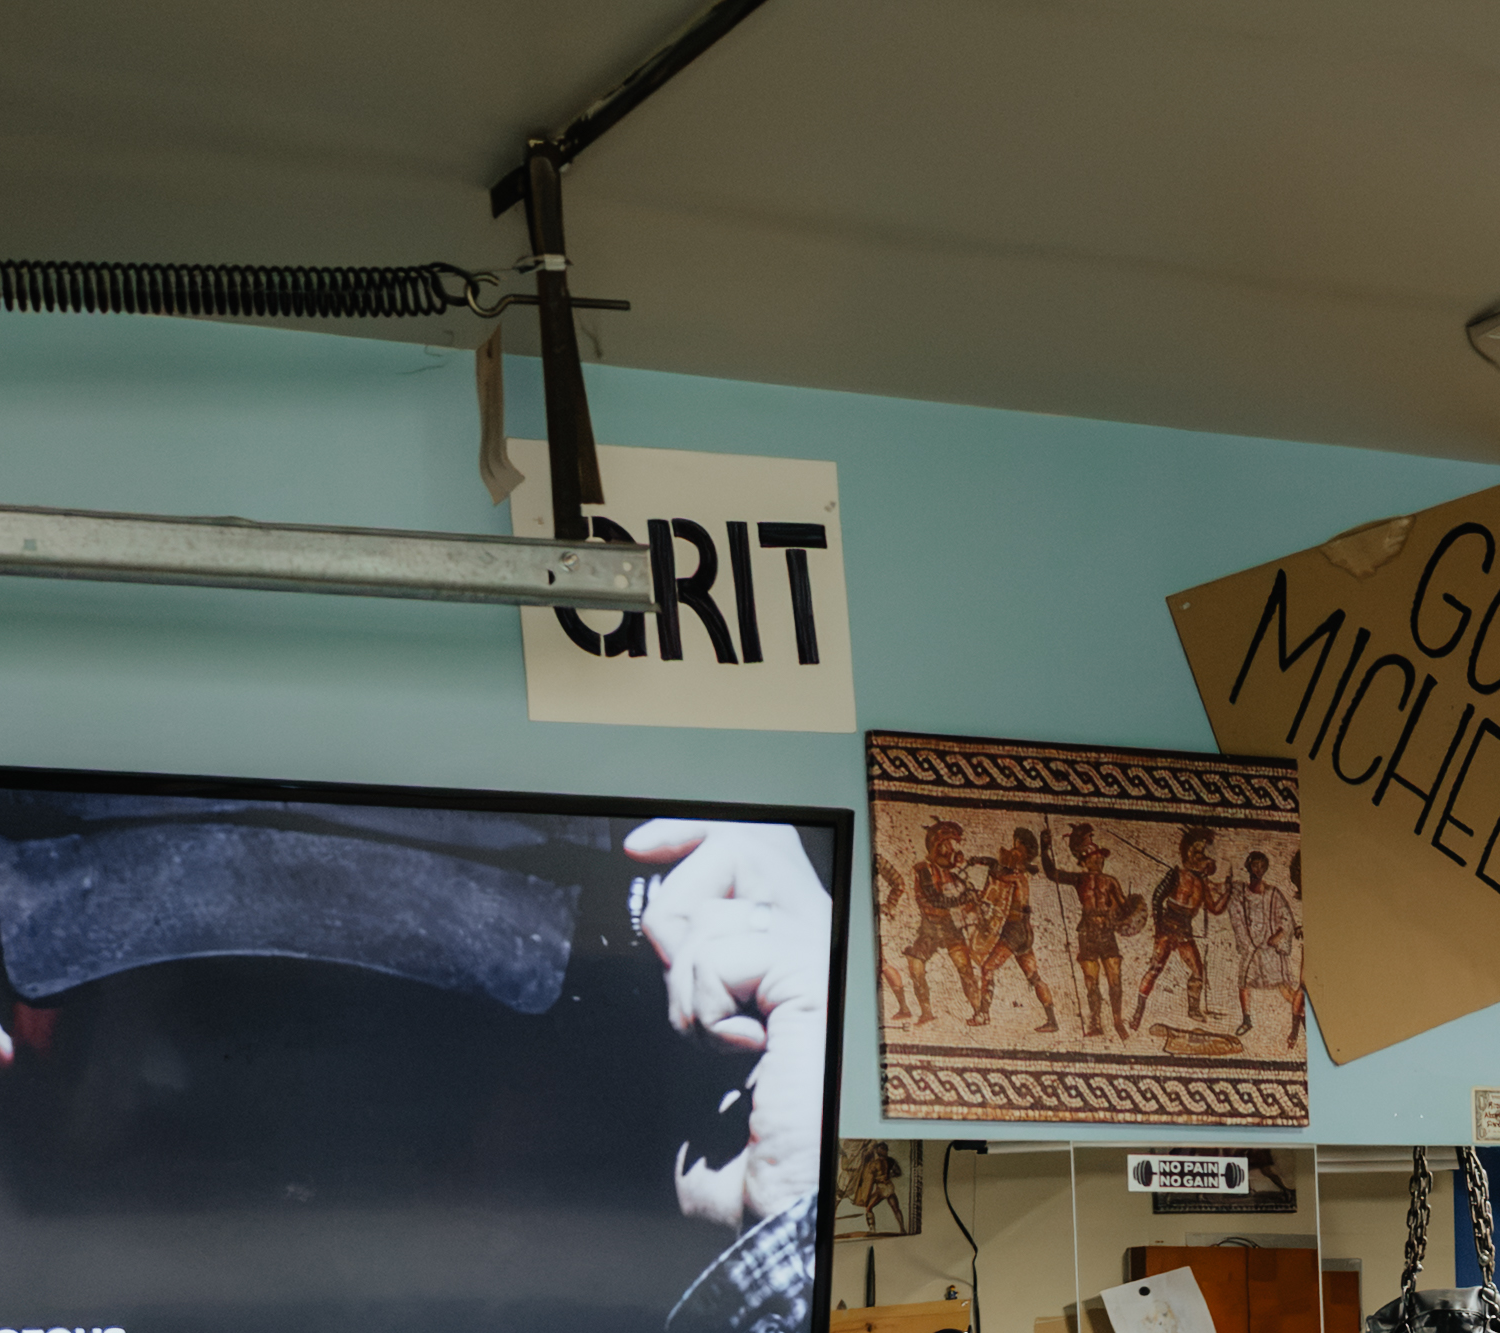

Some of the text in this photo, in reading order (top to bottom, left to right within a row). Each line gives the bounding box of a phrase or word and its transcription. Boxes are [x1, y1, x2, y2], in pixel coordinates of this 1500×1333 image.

[1159, 1160, 1220, 1175] NO PAIN
[1159, 1174, 1220, 1188] NO GAIN
